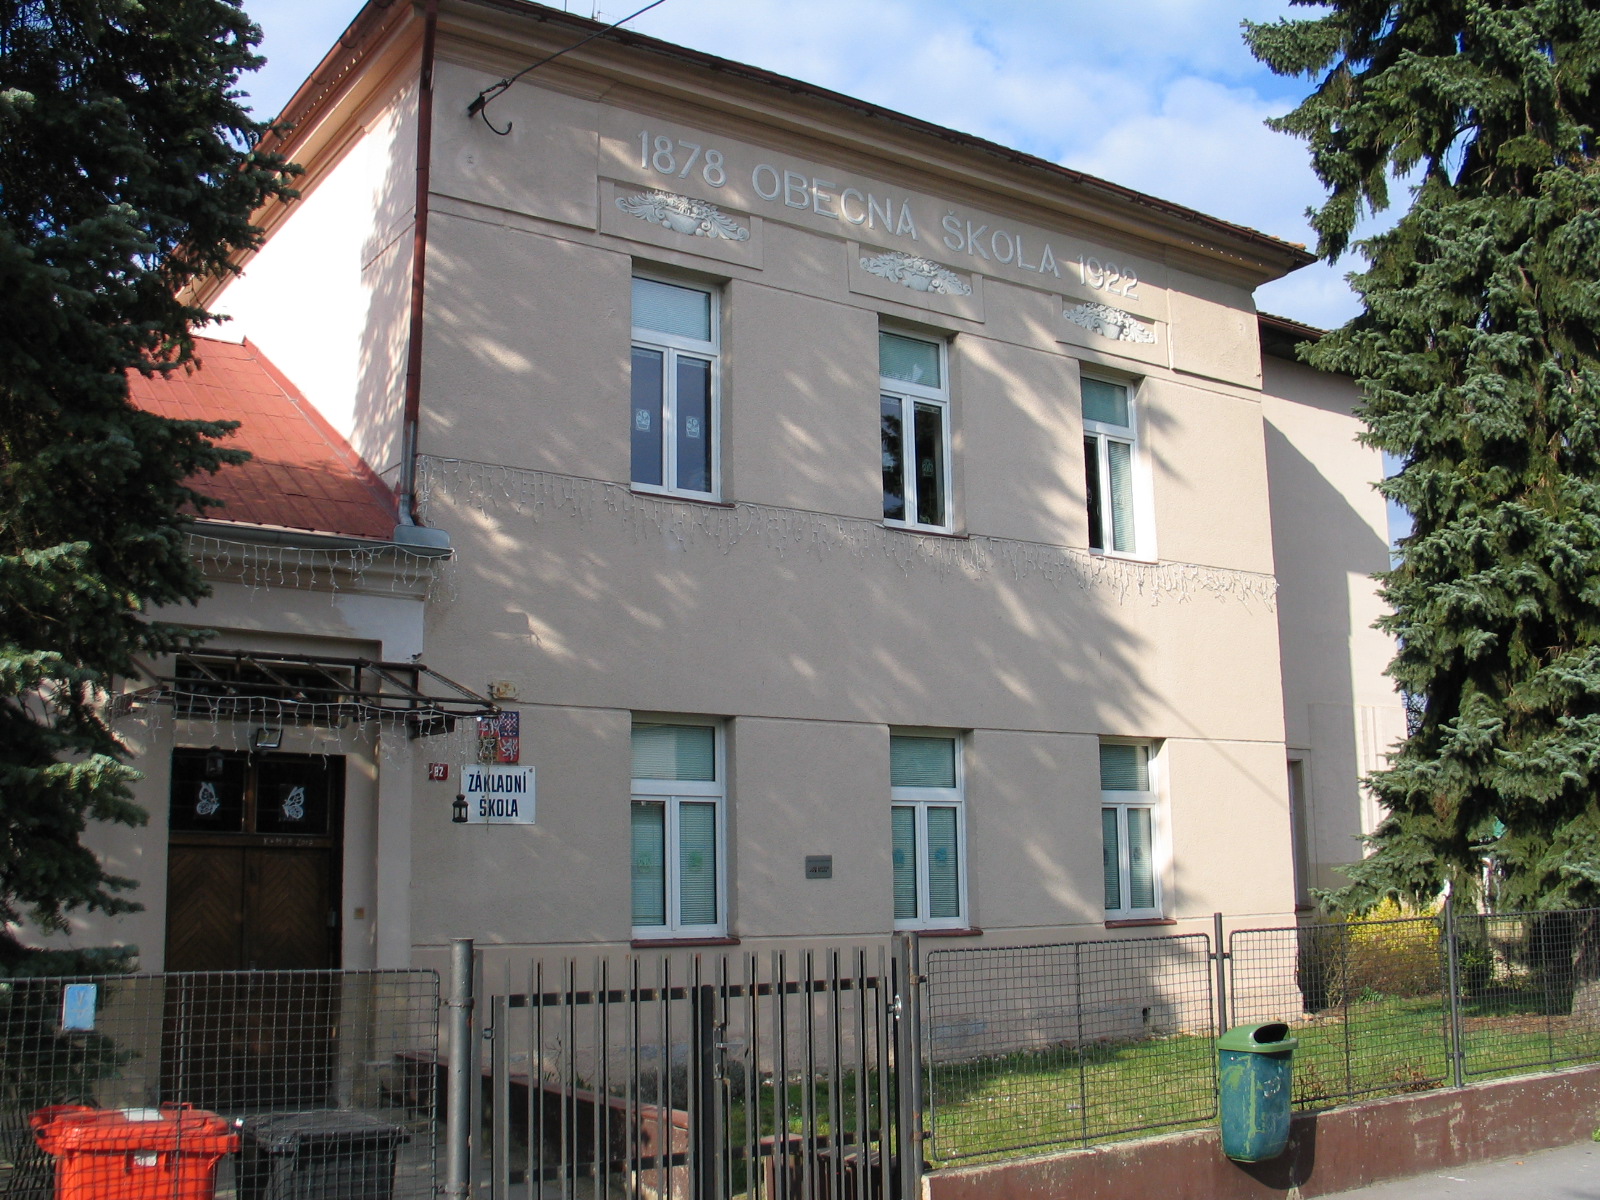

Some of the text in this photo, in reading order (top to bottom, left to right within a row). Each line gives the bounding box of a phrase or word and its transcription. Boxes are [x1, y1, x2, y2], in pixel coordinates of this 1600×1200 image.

[637, 130, 1139, 300] 1878 OBECNÁ ŠKOLA 1922
[468, 770, 527, 793] ZÁKLADNÍ
[479, 795, 519, 818] ŠKOLA
